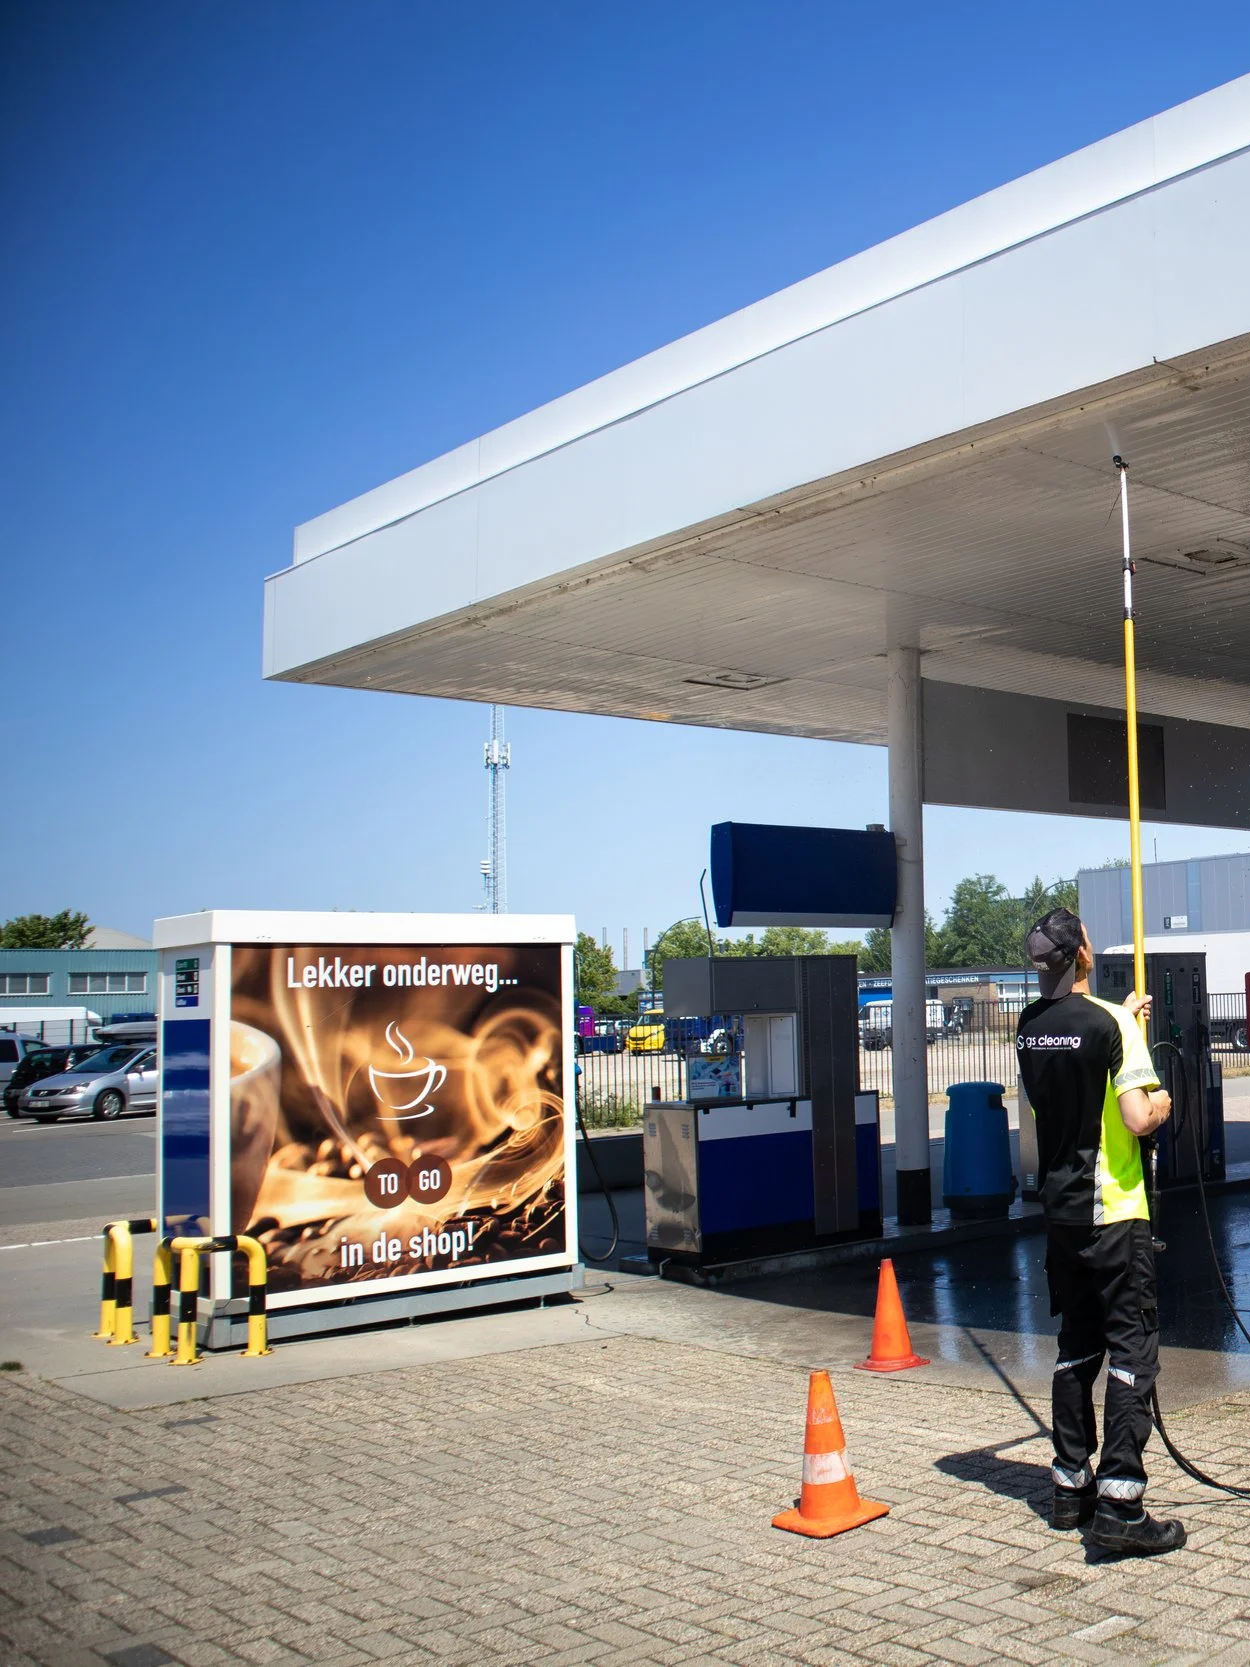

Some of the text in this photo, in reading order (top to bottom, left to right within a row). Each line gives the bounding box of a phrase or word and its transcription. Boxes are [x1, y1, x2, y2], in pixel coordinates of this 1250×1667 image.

[287, 956, 518, 993] Lekker onderweg...
[1025, 1035, 1082, 1049] gs cleaning
[377, 1169, 441, 1195] TO GO
[340, 1221, 474, 1268] in de shop!
